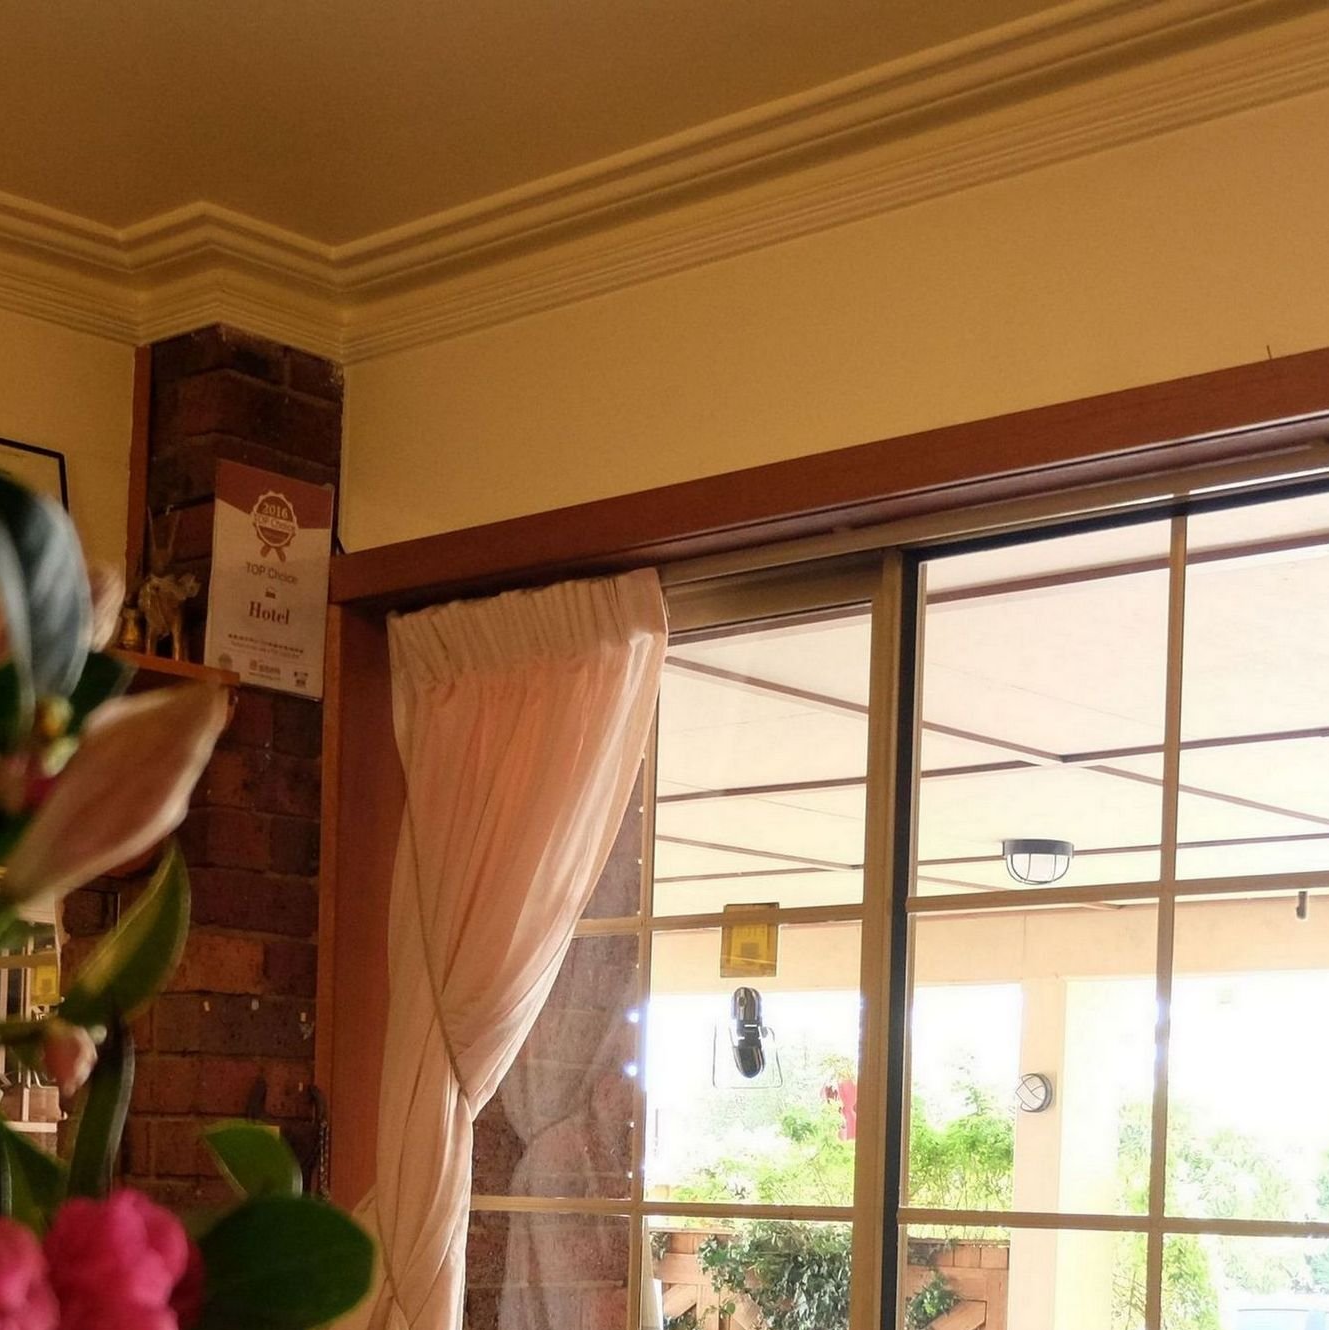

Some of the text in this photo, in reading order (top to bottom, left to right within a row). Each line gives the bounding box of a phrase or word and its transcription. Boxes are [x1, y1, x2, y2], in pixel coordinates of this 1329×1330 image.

[261, 501, 289, 520] 2016
[246, 561, 298, 584] TOP Choice
[248, 601, 290, 625] Hotel
